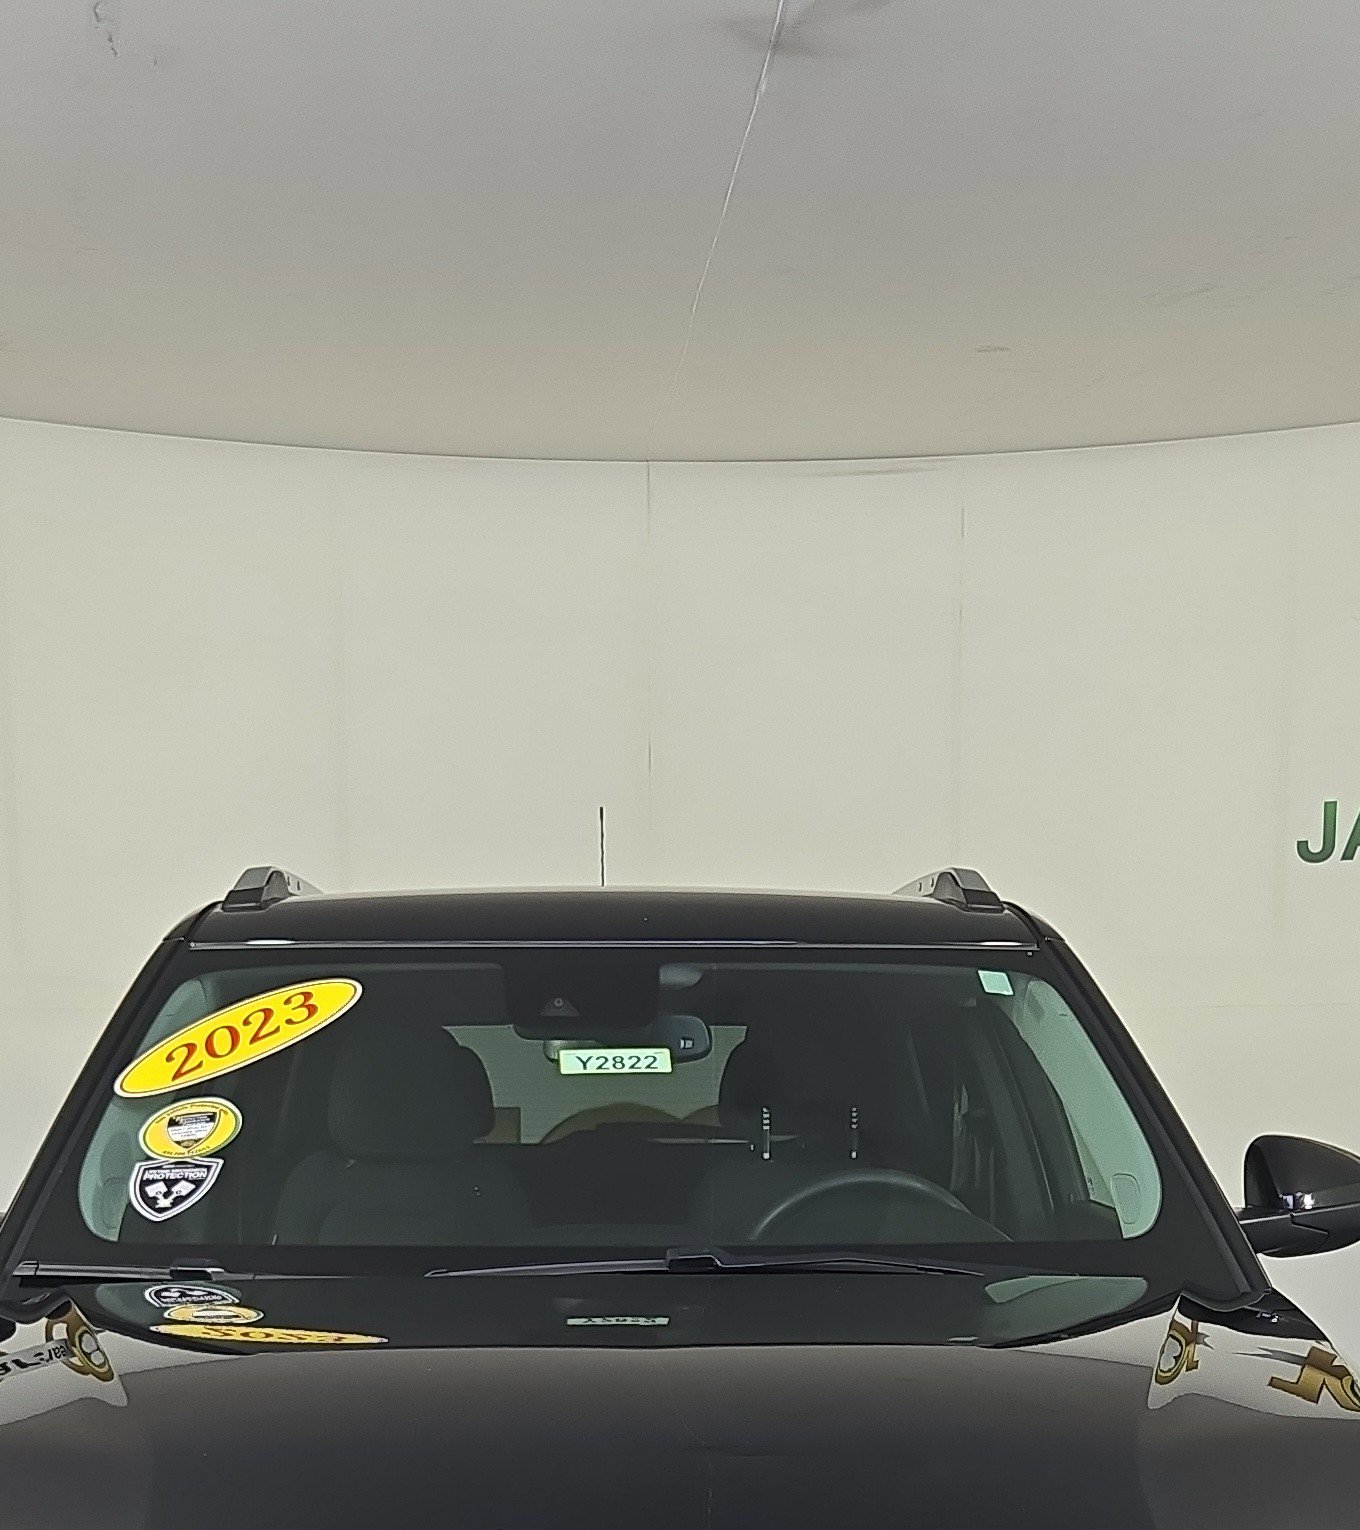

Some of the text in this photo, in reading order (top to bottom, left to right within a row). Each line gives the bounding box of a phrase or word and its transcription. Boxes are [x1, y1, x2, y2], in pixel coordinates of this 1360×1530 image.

[165, 990, 319, 1082] 2023
[576, 1055, 658, 1071] Y2822
[143, 1170, 207, 1181] PROTECTION
